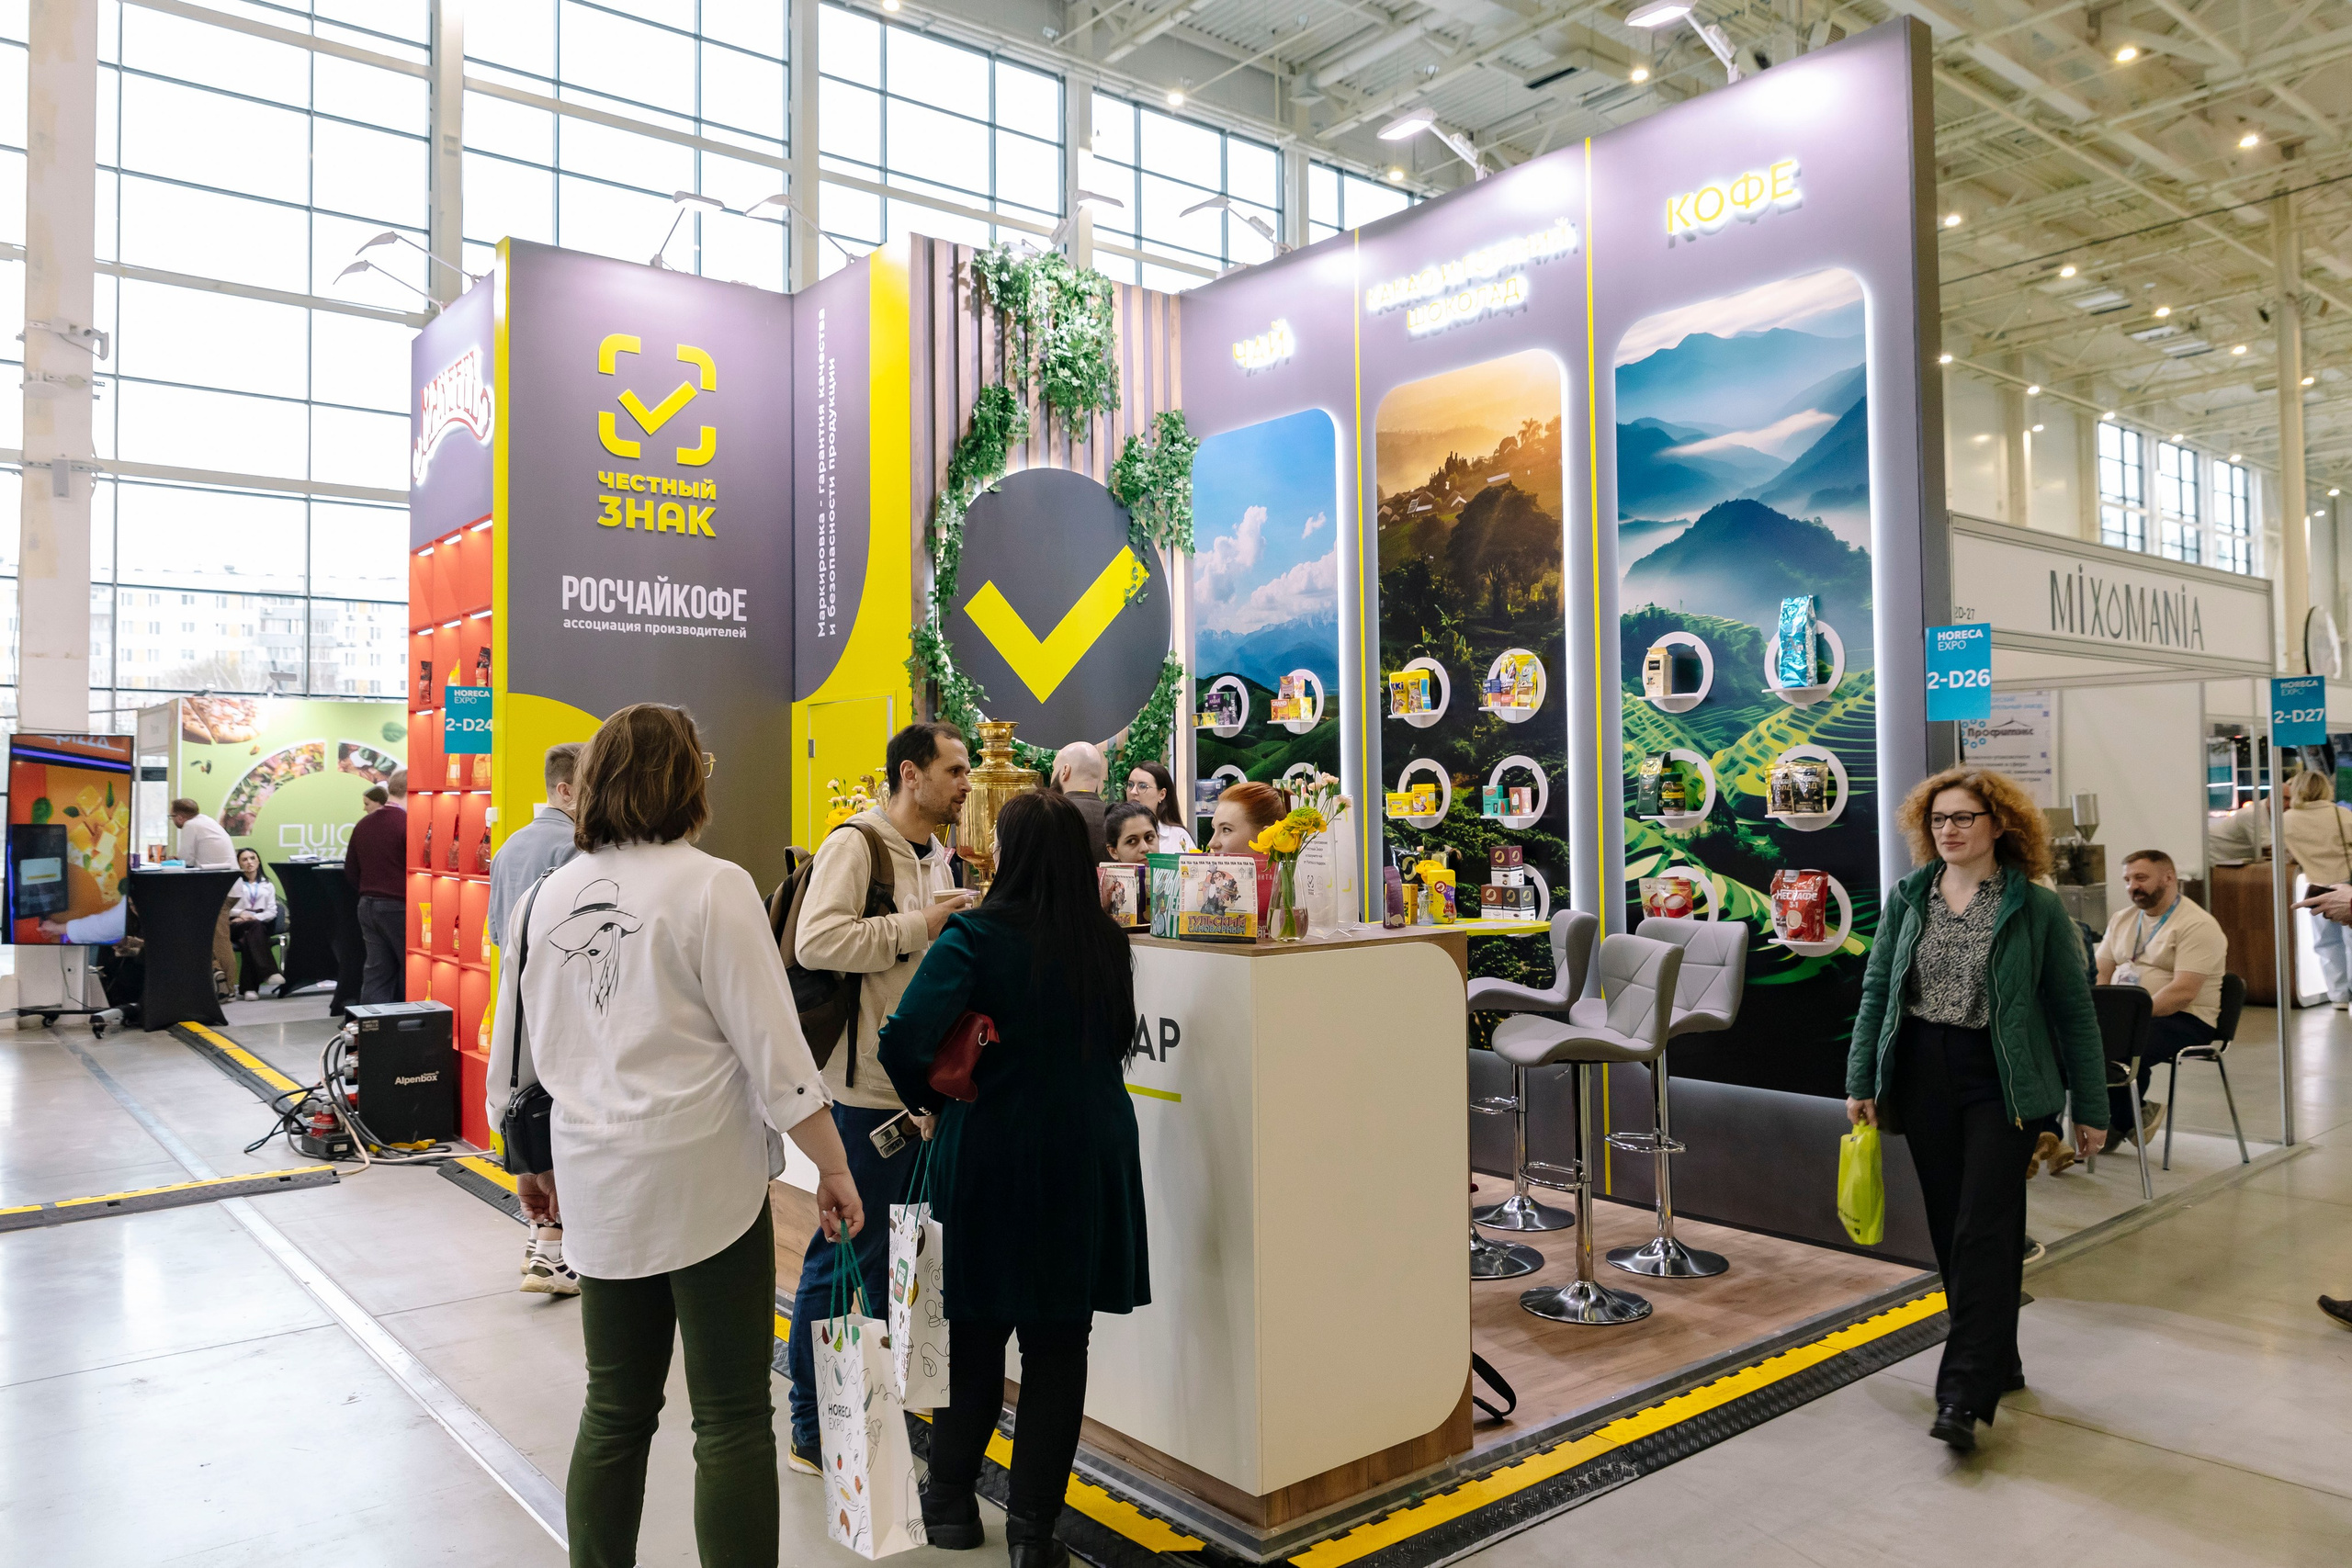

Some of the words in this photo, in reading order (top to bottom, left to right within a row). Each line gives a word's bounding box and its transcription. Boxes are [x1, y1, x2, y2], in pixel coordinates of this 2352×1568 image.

[1666, 159, 1796, 234] КОФЕ
[1366, 267, 1435, 311] КАКАО
[1407, 277, 1522, 331] ШОКОЛАД
[818, 308, 826, 398] качества
[1232, 319, 1291, 369] ЧАЙ
[828, 357, 837, 469] продукции
[818, 404, 827, 493] гарантия
[598, 470, 717, 501] ЧЕСТНЫЙ
[597, 494, 717, 537] ЗНАК
[827, 476, 836, 617] безопасности
[818, 513, 827, 637] Маркировка
[562, 575, 748, 622] РОСЧАЙКОФЕ
[563, 618, 641, 633] ассоциация
[644, 621, 747, 638] производителей
[829, 624, 836, 636] и
[1937, 629, 1984, 641] HORECA
[1938, 640, 1966, 651] EXPO
[1927, 669, 1991, 690] 2-D26
[2280, 679, 2318, 689] HORECA
[445, 717, 492, 731] 2-D24
[2273, 708, 2324, 724] 2-D27
[1187, 915, 1247, 928] ТУЛЬСКИЙ
[394, 1075, 437, 1086] Alpenbox
[828, 1403, 853, 1418] HORECA
[828, 1416, 844, 1432] EXPO
